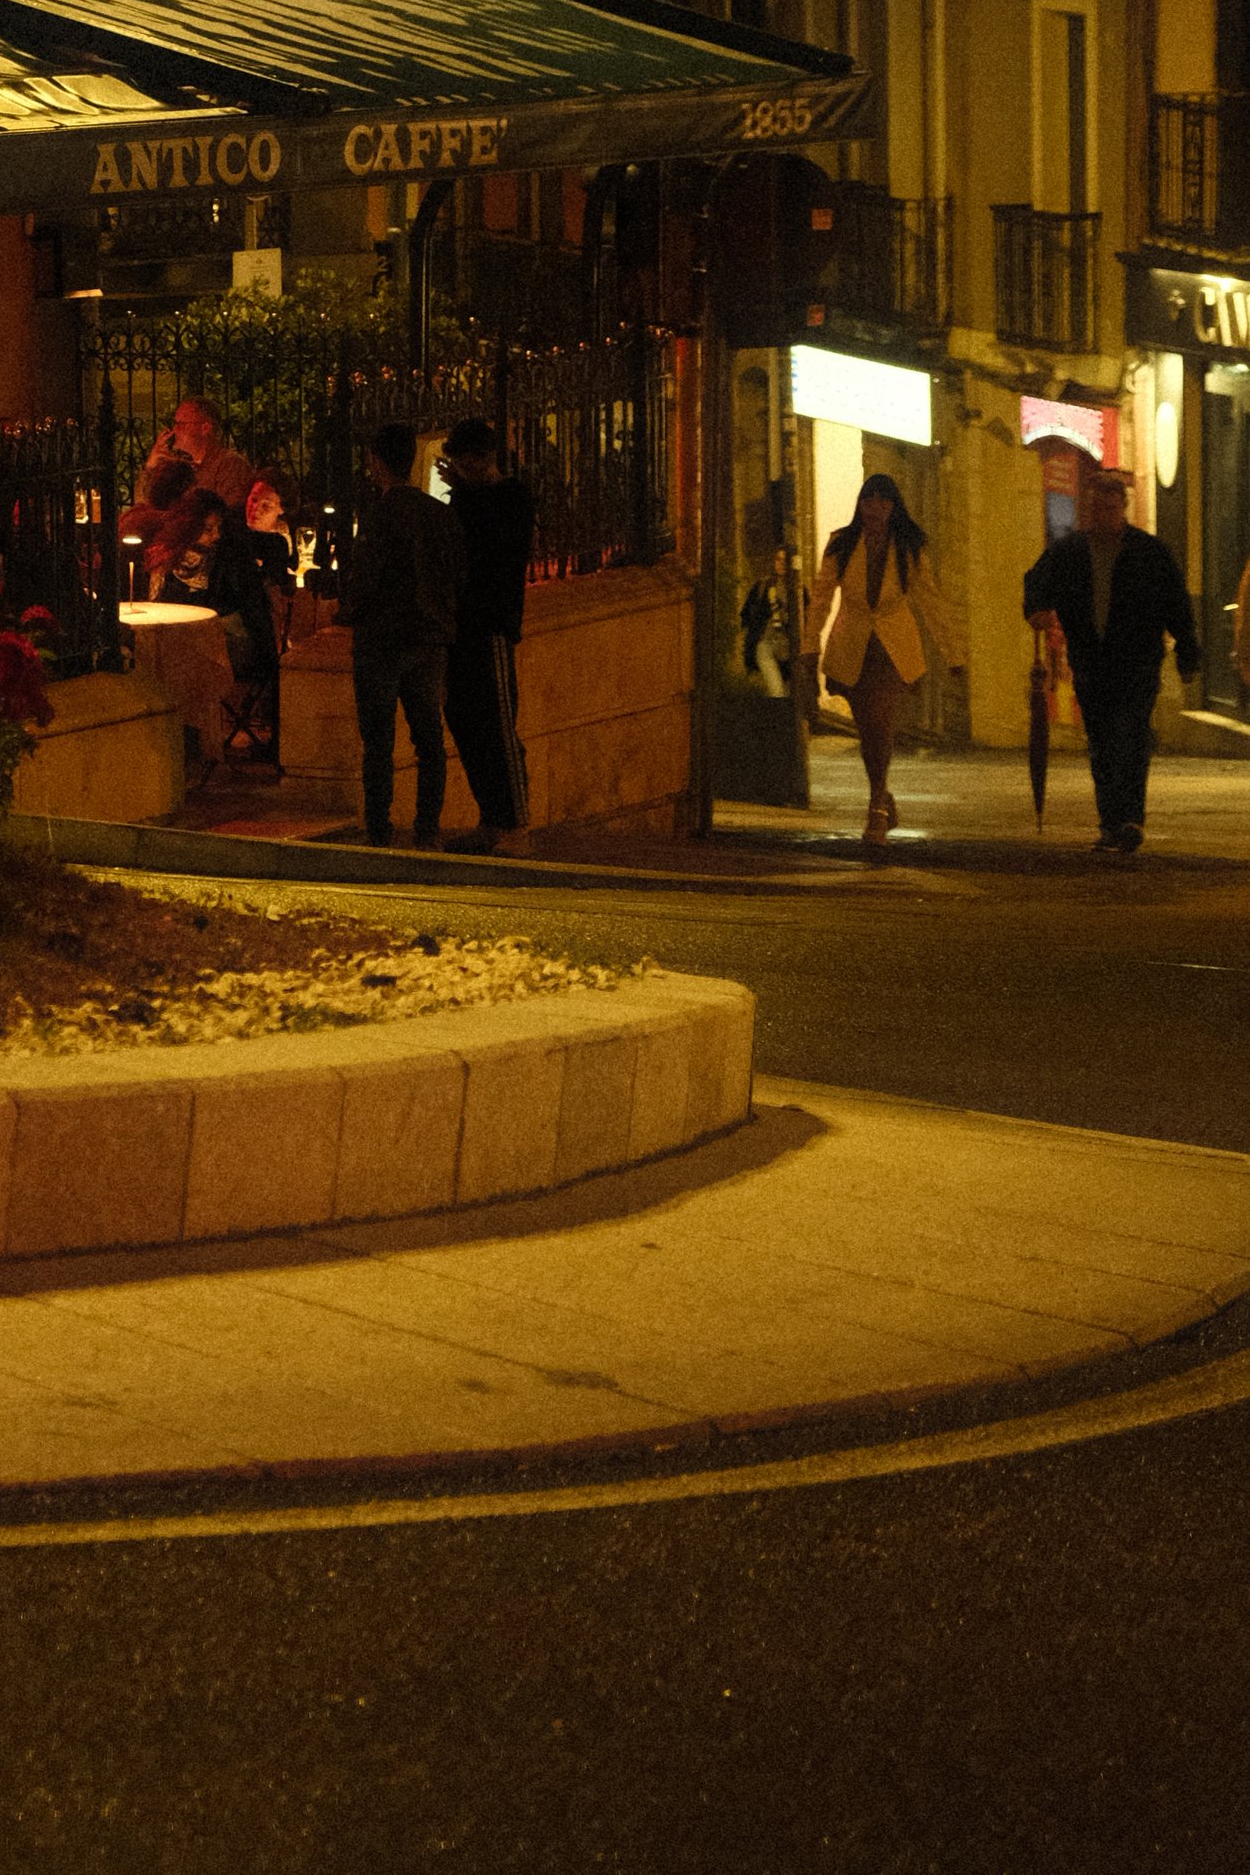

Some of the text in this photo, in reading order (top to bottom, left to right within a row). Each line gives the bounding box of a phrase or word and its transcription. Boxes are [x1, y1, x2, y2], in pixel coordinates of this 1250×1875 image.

[741, 98, 812, 140] 1855
[90, 117, 508, 195] ANTICO CAFFE'
